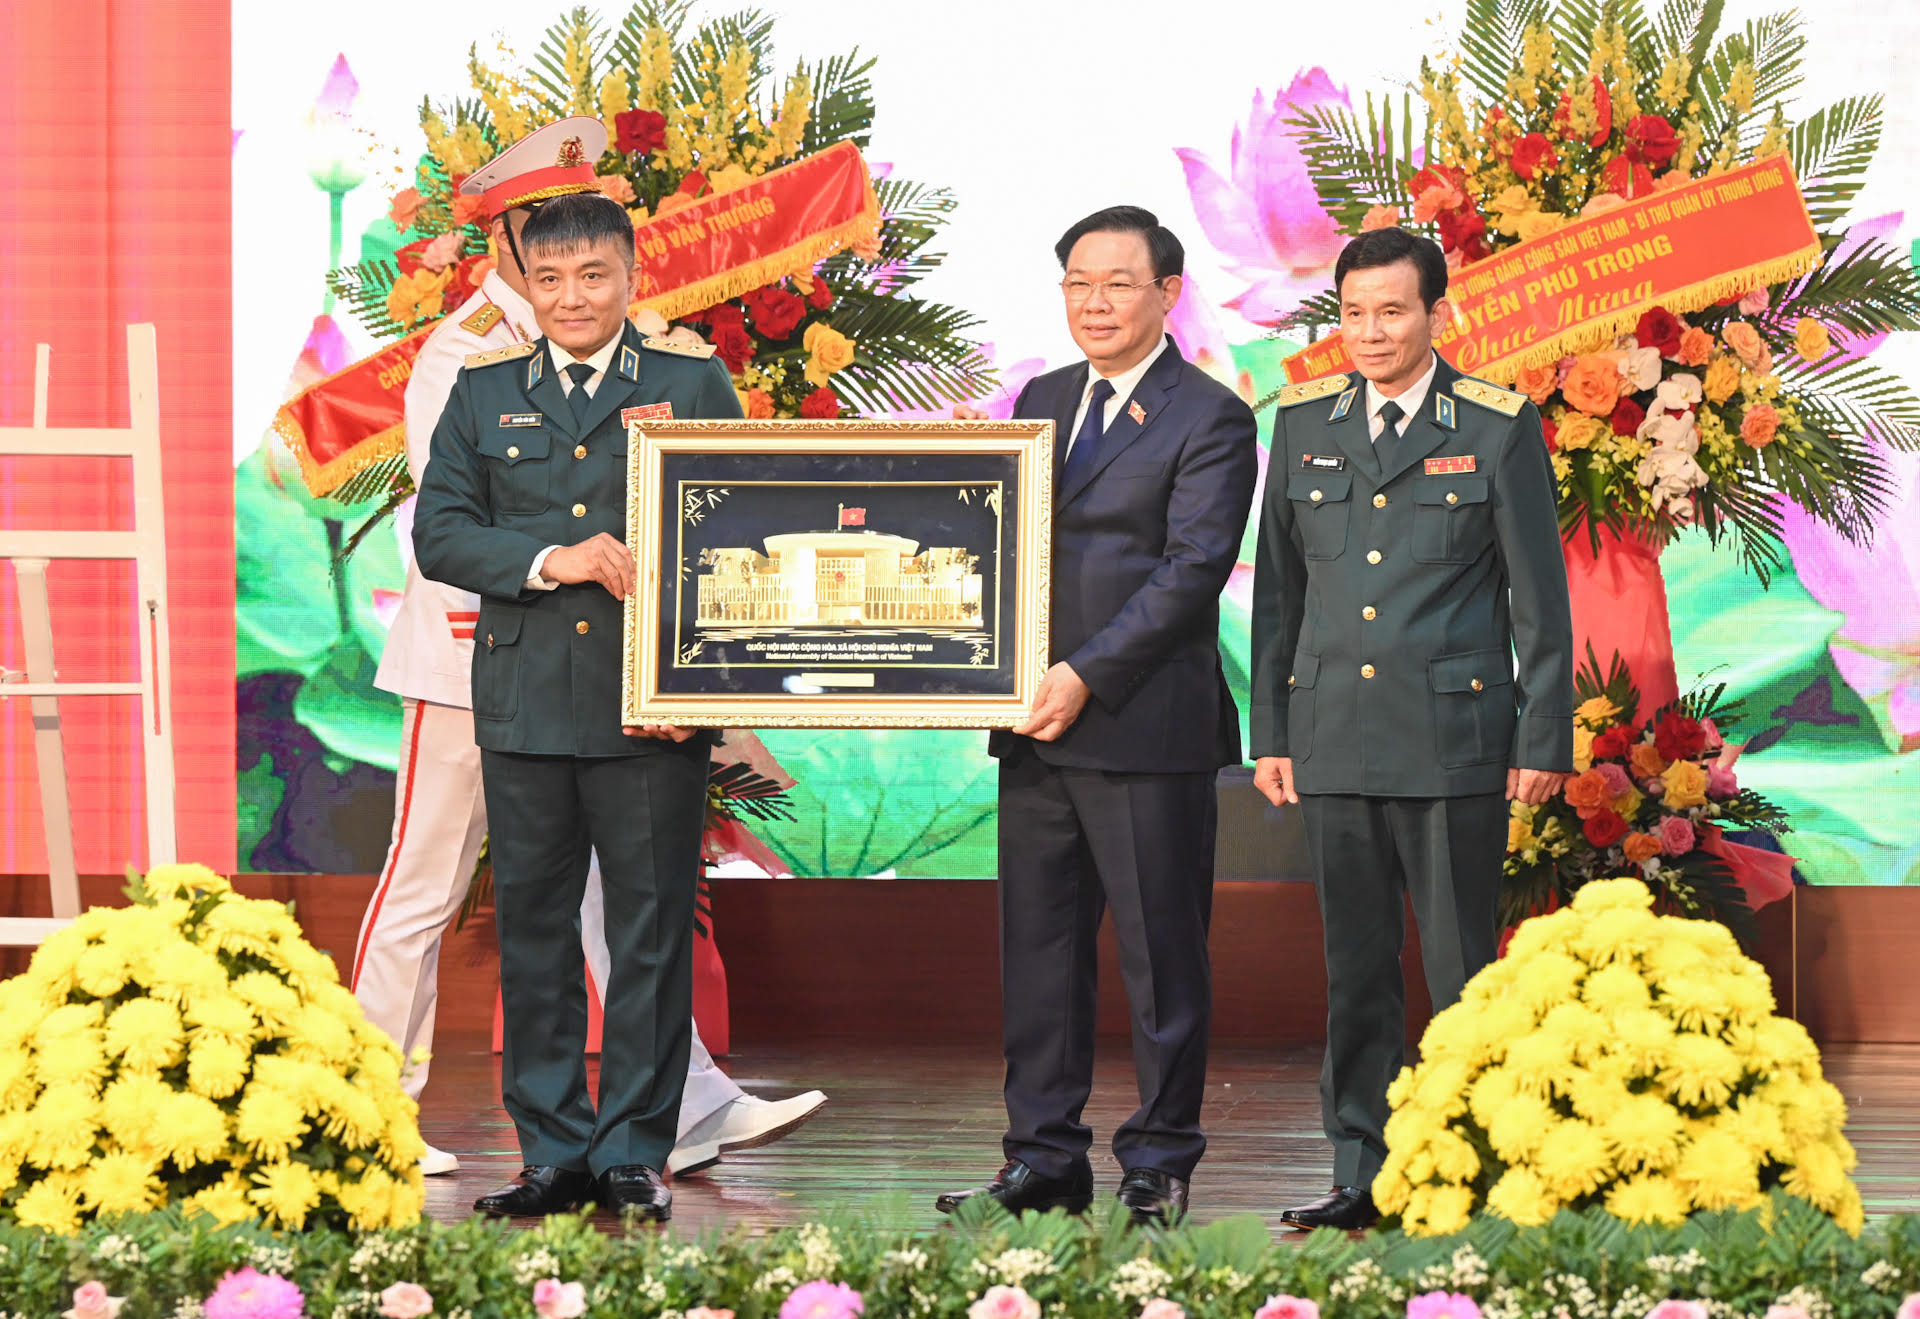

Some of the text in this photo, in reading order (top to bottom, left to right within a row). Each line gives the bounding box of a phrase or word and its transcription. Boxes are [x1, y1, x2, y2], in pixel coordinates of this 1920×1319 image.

[667, 221, 706, 249] VĂN
[704, 197, 776, 234] THƯỞNG
[1465, 269, 1497, 297] ƯƠNG
[1495, 257, 1526, 284] ĐẢNG
[1524, 244, 1555, 271] CỘNG
[1553, 233, 1579, 259] SẢN
[1577, 225, 1603, 250] VIỆT
[1601, 217, 1630, 241] NAM
[1634, 210, 1650, 230] BÍ
[1648, 201, 1672, 228] THƯ
[1670, 193, 1702, 219] QUÂN
[1715, 177, 1754, 204] TRUNG
[1753, 167, 1785, 192] ƯƠNG
[1524, 263, 1579, 305] PHÚ
[1582, 234, 1673, 281] TRỌNG
[1457, 279, 1653, 372] Chúc Mừng
[378, 354, 412, 390] CHỦ
[746, 641, 766, 651] QUỐC
[800, 642, 821, 652] CỘNG
[822, 642, 836, 651] HÒA
[900, 642, 916, 652] VIỆT
[916, 643, 933, 651] NAM
[766, 652, 791, 660] National
[791, 652, 820, 661] Assembly
